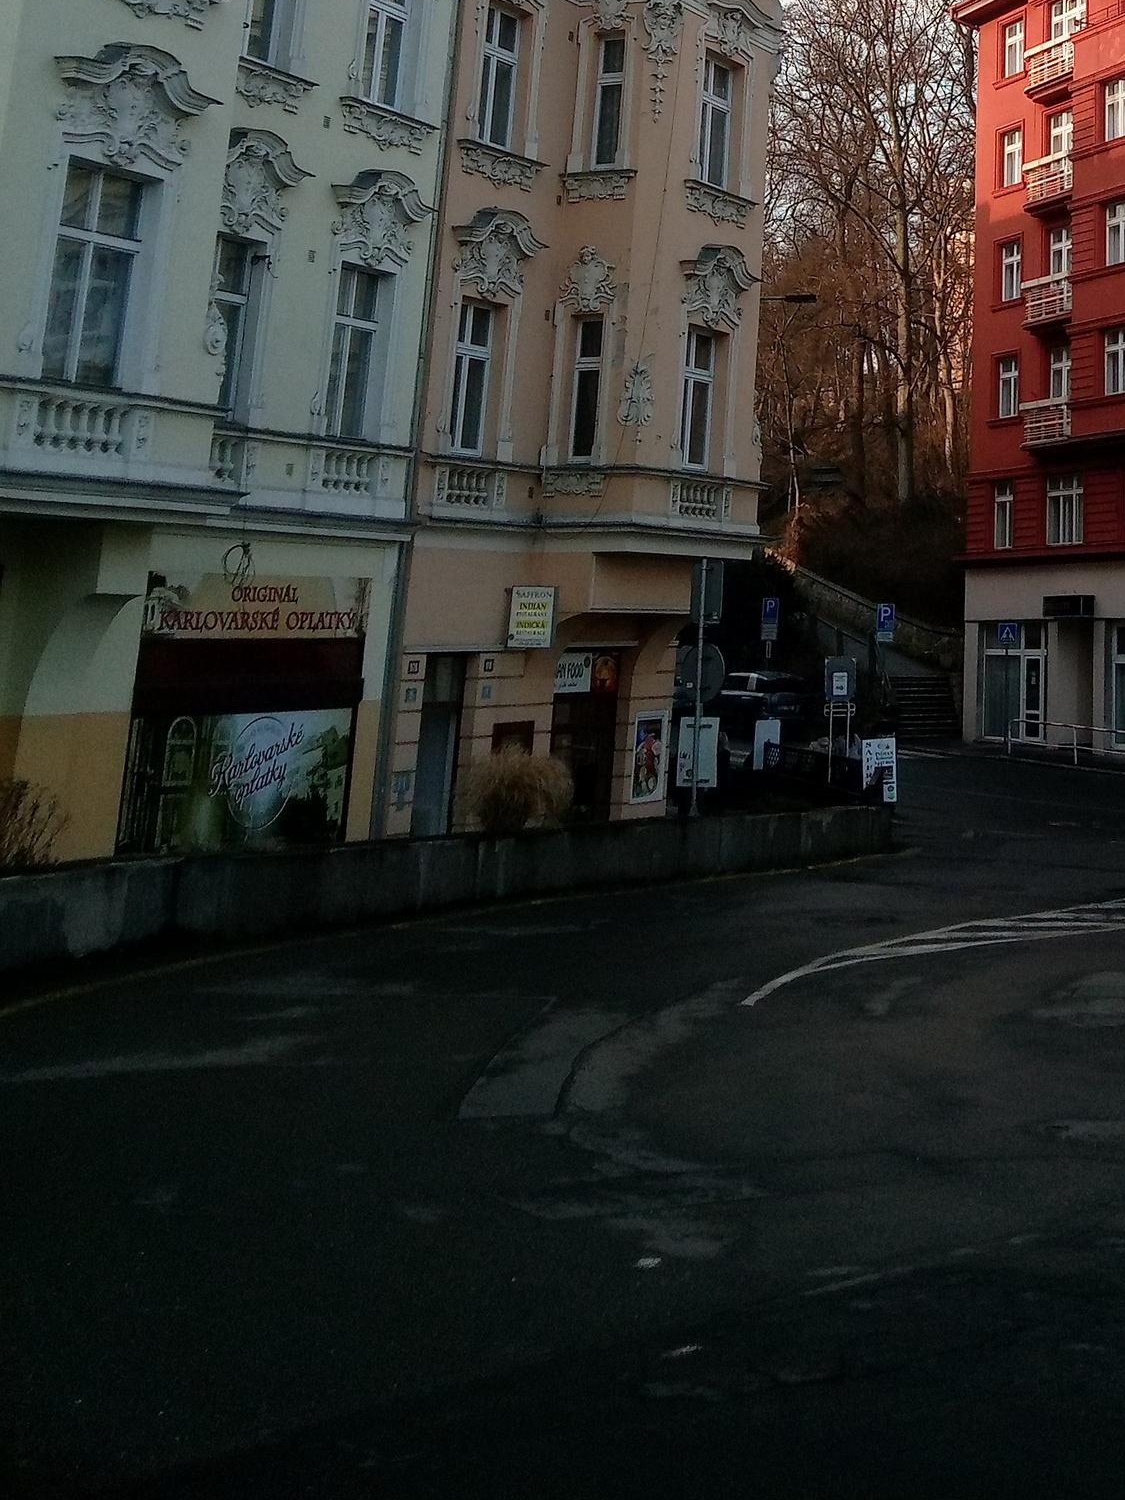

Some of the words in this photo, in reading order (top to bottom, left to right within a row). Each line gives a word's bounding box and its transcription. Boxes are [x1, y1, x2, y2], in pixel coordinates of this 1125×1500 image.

[519, 602, 547, 610] INDIAN
[766, 599, 776, 613] P
[159, 607, 281, 633] KARLOVARSKÉ
[880, 606, 892, 622] P
